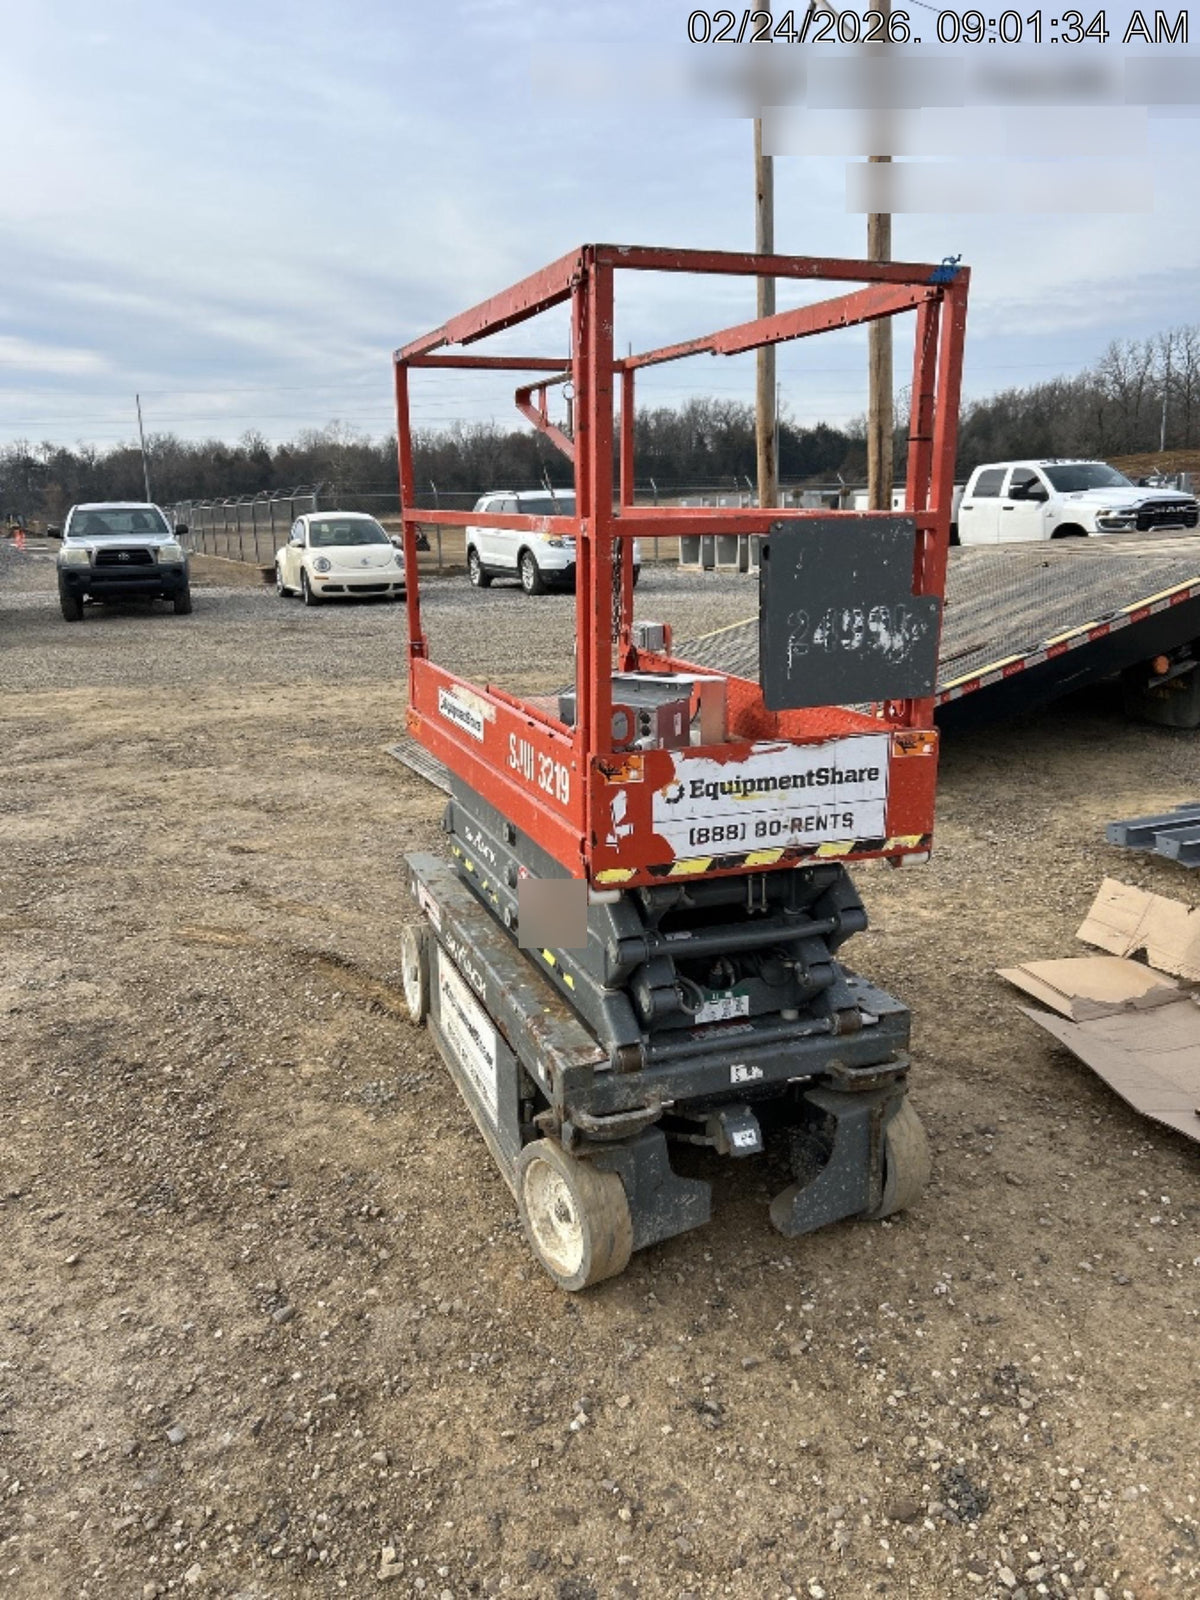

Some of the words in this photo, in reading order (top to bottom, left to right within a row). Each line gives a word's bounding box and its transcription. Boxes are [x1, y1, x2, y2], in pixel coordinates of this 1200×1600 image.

[538, 752, 570, 805] 3219
[689, 766, 880, 801] EquipmentShare
[689, 822, 746, 846] (888)
[755, 811, 855, 838] 80-RENTS
